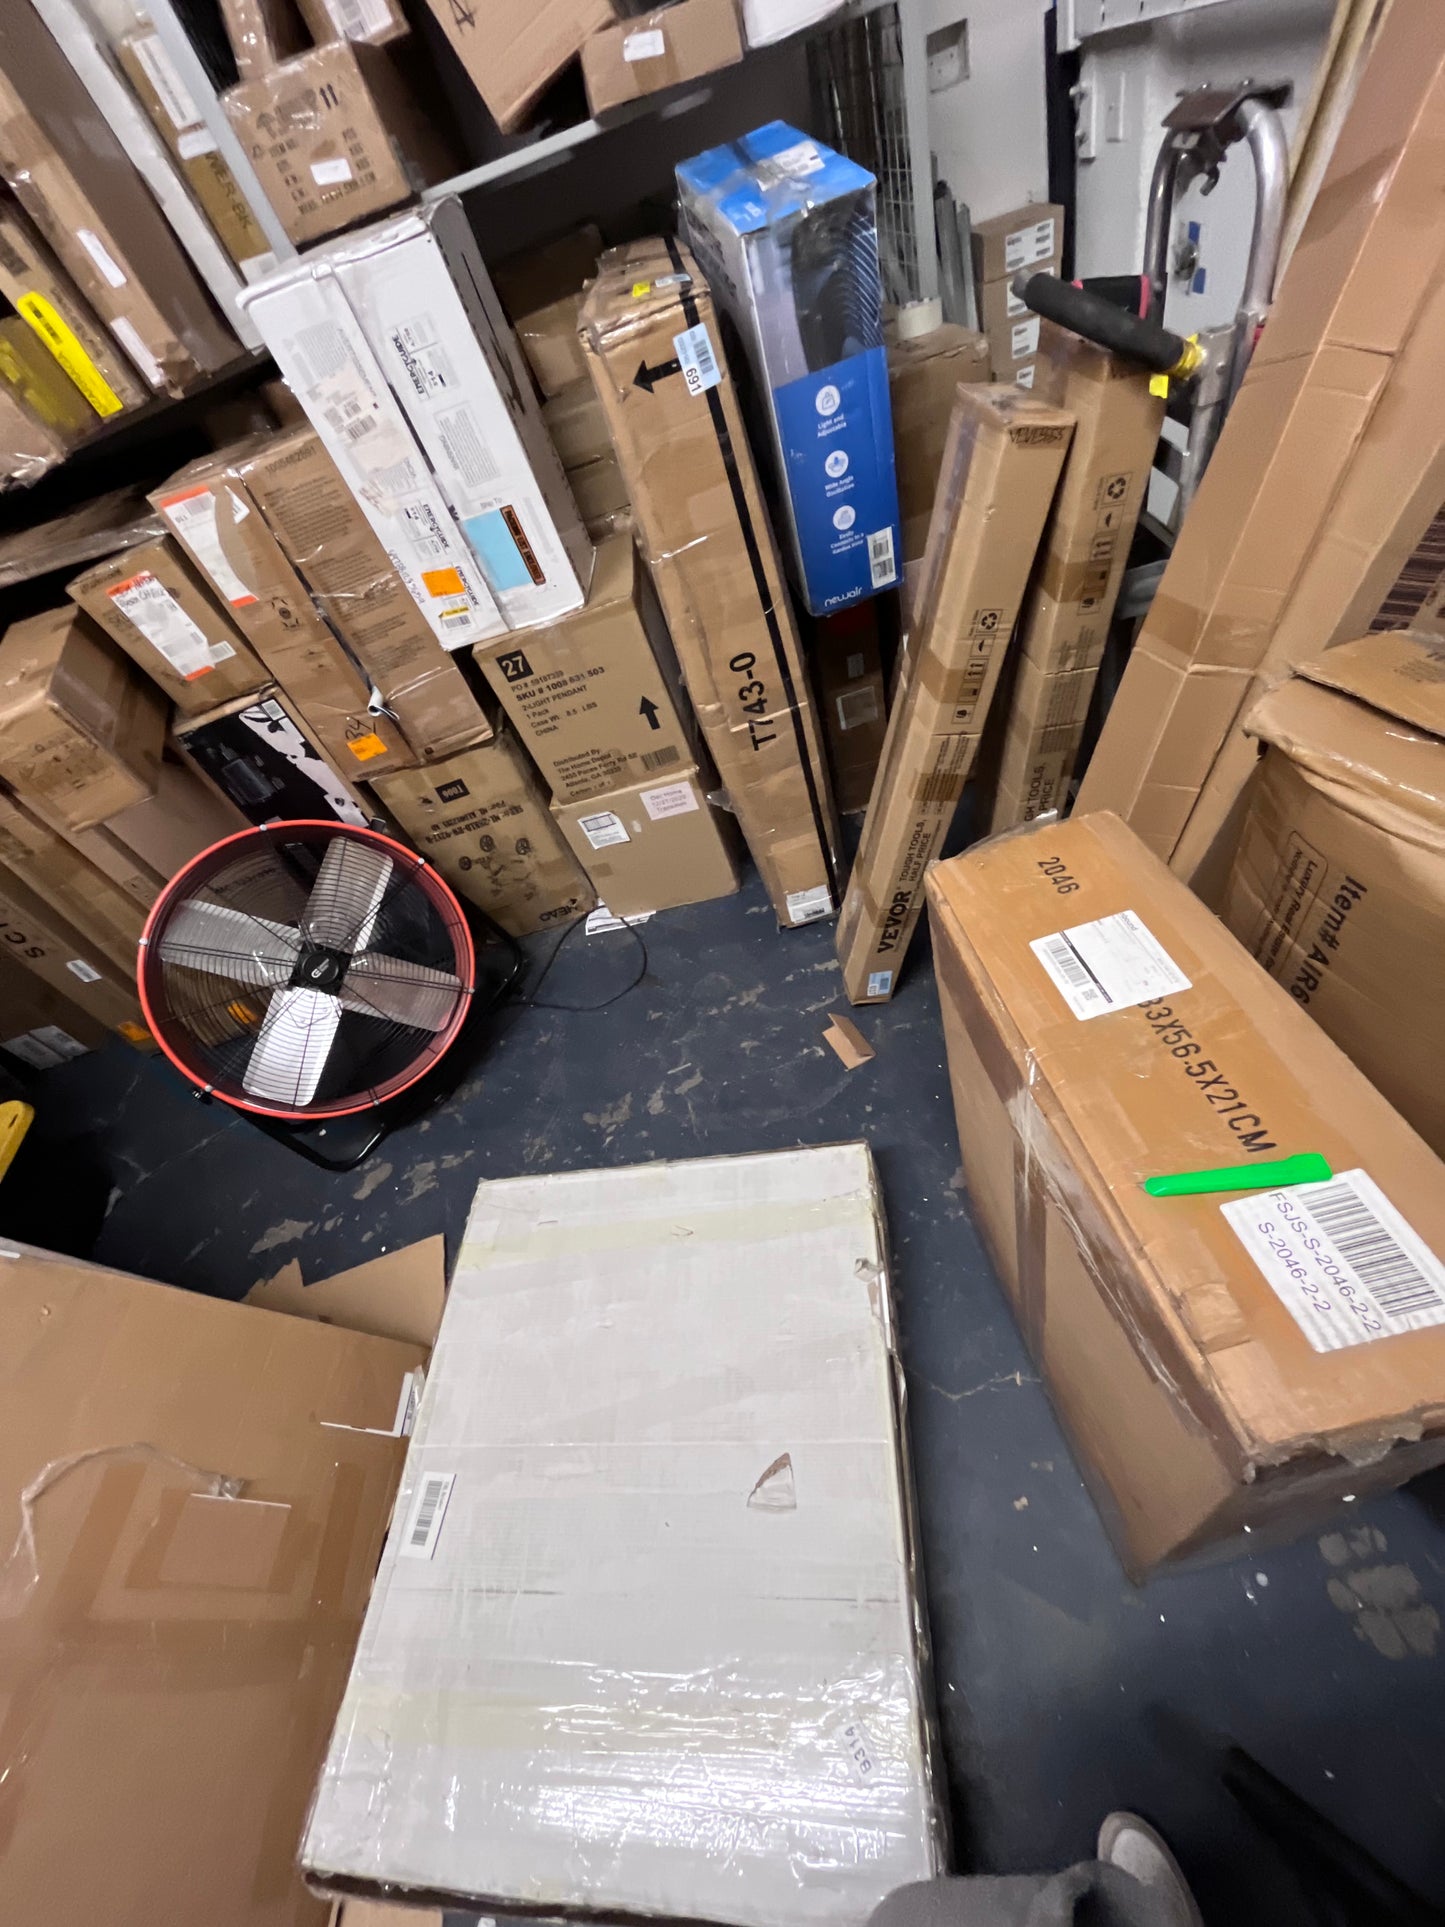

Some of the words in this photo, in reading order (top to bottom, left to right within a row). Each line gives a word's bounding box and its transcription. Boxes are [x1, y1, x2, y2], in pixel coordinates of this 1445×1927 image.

[686, 367, 702, 392] 691
[825, 586, 863, 607] newair
[501, 655, 524, 678] 27
[515, 690, 536, 702] SKU
[587, 666, 605, 678] 503
[522, 694, 551, 712] 2-LIGHT
[552, 684, 588, 702] PENDANT
[532, 708, 549, 719] Pack
[729, 651, 777, 752] T743-0
[536, 726, 559, 737] CHINA
[553, 750, 590, 768] Distributed
[558, 765, 570, 775] The
[571, 759, 591, 771] Home
[899, 853, 914, 882] TOUGH
[908, 819, 928, 853] TOOLS,
[909, 859, 922, 883] HALF
[917, 832, 932, 860] PRICE
[1037, 856, 1081, 895] 2046
[1296, 860, 1319, 901] Luxury
[877, 890, 912, 954] VEVOR
[1317, 875, 1368, 951] Item#
[1290, 943, 1330, 1005] AIR6
[1258, 1222, 1331, 1313] S-2046-2-2
[1269, 1192, 1382, 1333] FSJS-S-2046-2-2
